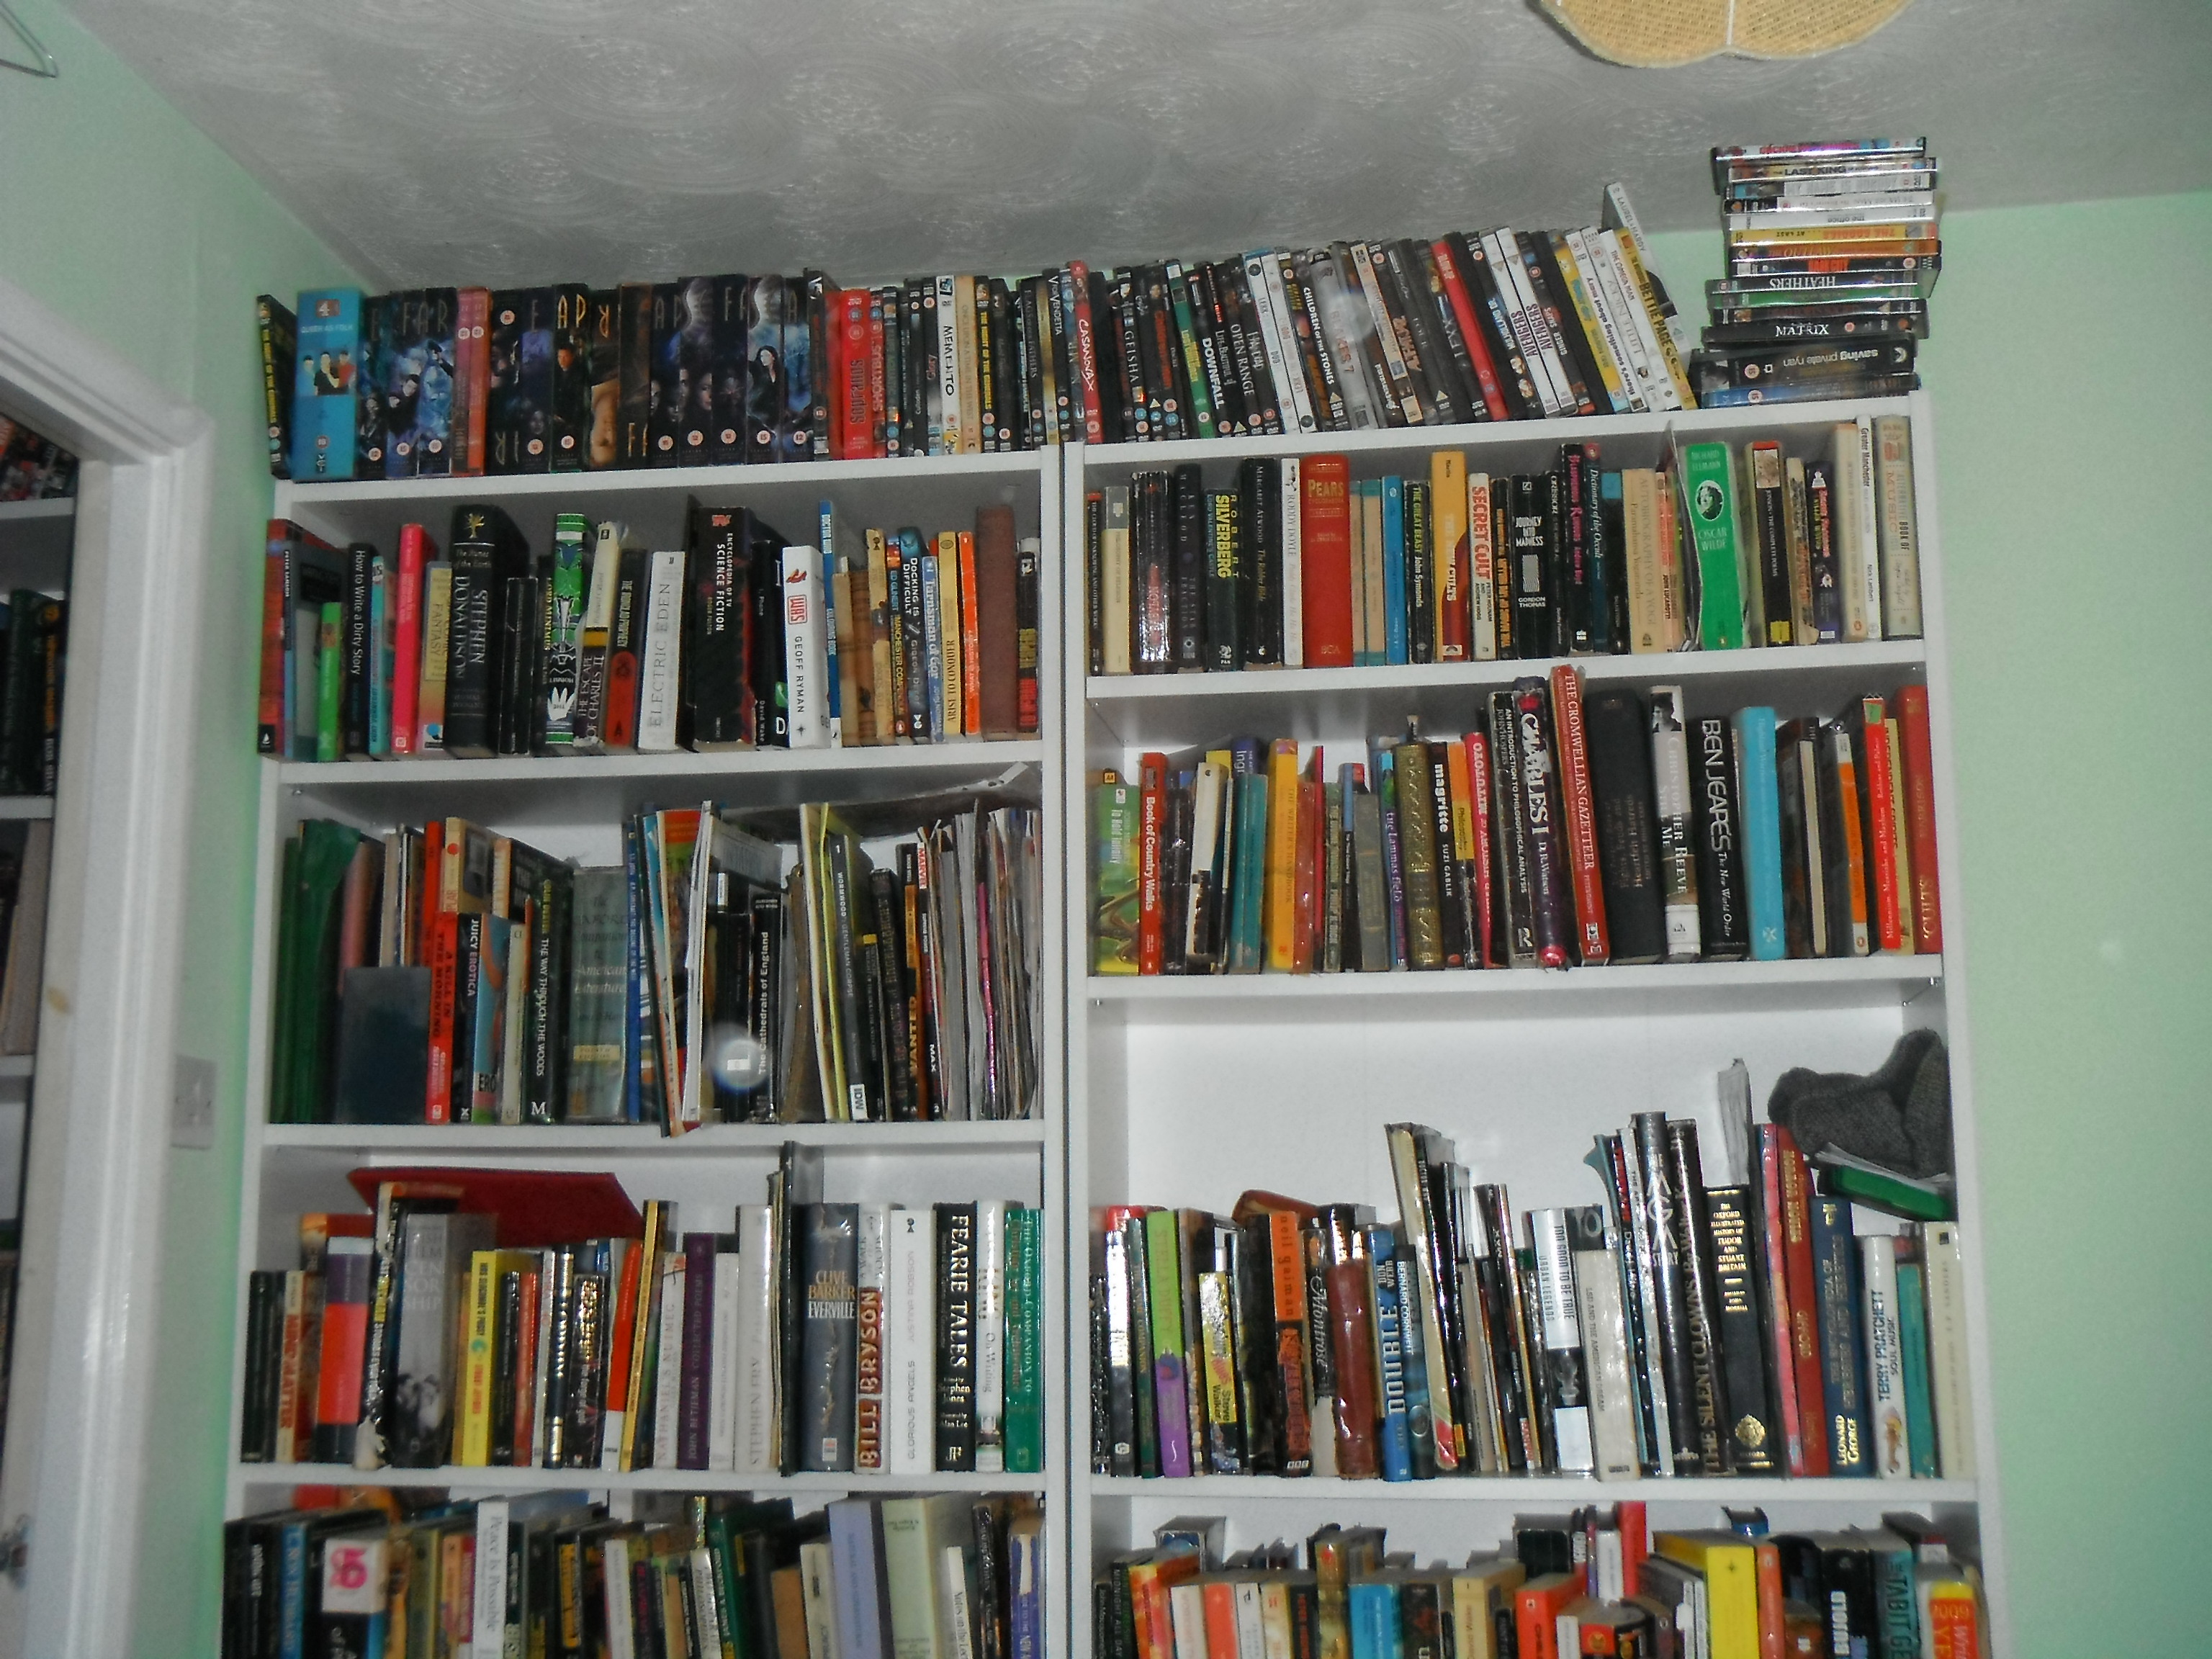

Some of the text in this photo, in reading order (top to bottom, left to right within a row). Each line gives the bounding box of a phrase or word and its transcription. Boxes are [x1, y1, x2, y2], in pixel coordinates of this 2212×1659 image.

[1818, 166, 1846, 174] KING
[1617, 197, 1632, 224] LAUREL
[1049, 276, 1058, 284] V
[1770, 276, 1835, 288] HEATHERS
[1048, 295, 1062, 335] VENDETTA
[1303, 287, 1321, 329] CHILDREN
[1321, 352, 1334, 385] STONES
[1512, 311, 1537, 357] AVENGERS
[1527, 305, 1552, 349] AVENGERS
[1587, 278, 1636, 395] there's something about mary
[1640, 284, 1670, 346] BETTIE PAGE
[1776, 324, 1829, 336] MATRIX
[943, 325, 955, 395] MEMENTO
[1078, 319, 1094, 382] CASANOVA
[1124, 331, 1140, 382] GEISHA
[1202, 338, 1224, 409] DOWNFALL
[1230, 325, 1255, 396] OPEN RANGE
[1783, 349, 1879, 368] saving private ryan
[1591, 469, 1601, 510] Dictionary
[1862, 452, 1871, 486] Manchester
[1413, 487, 1422, 501] THE
[1887, 471, 1897, 532] MUSIC
[1215, 495, 1231, 578] SILVERBERG
[1287, 527, 1296, 557] DOYLE
[1472, 487, 1490, 579] SECRET CULT
[1593, 533, 1602, 559] Occult
[1899, 522, 1908, 539] BOOK
[354, 551, 365, 572] How
[354, 574, 364, 583] to
[1414, 556, 1423, 572] John
[1645, 572, 1653, 585] OF
[354, 586, 365, 611] Write
[716, 544, 724, 631] SCIENCE FICTION
[726, 598, 732, 606] TV
[910, 558, 920, 616] DOCKING IS
[1414, 575, 1423, 607] Symonds
[351, 623, 363, 647] Dirty
[454, 576, 469, 678] DONALDSON
[469, 590, 487, 664] STEPHEN
[925, 579, 939, 678] Tarnsman of Gor
[351, 649, 362, 675] Story
[649, 583, 670, 727] ELECTRIC EDEN
[577, 657, 590, 717] THE ESCAPE
[586, 723, 596, 738] OF
[595, 655, 604, 668] II
[948, 684, 956, 693] TO
[948, 697, 956, 721] ARISE
[1565, 674, 1593, 869] THE CROMWELLIAN GAZETTEER
[1702, 720, 1727, 852] BEN JEAPES
[1506, 709, 1527, 893] AN INTRODUCTION TO PHILOSOPHICAL ANALYSIS
[1435, 764, 1448, 832] magritte
[1444, 866, 1452, 896] GABLIK
[918, 848, 927, 889] MARVEL
[1143, 797, 1155, 910] Book of Country Walks
[1675, 848, 1689, 892] REEVE
[837, 872, 847, 916] WORMWOOD
[468, 919, 479, 996] JUICY EROTICA
[759, 932, 768, 981] England
[536, 938, 549, 1076] THE WAY THROUGH THE WOODS
[760, 984, 768, 997] of
[855, 1087, 865, 1110] IDW
[1278, 1216, 1295, 1316] neil gaiman
[1560, 1271, 1569, 1282] TO
[949, 1215, 968, 1367] FEARIE TALES
[1398, 1261, 1413, 1354] BERNARD CORNWELL
[1560, 1285, 1570, 1295] BE
[1563, 1299, 1574, 1319] TRUE
[1310, 1277, 1327, 1366] Montrose
[984, 1332, 997, 1392] On Writing
[1380, 1305, 1406, 1414] DOUBLE
[1871, 1291, 1891, 1401] TERRY PRATCHETT
[859, 1292, 880, 1467] BILL BRYSON
[1213, 1385, 1223, 1419] Walker
[1223, 1390, 1231, 1421] Steve
